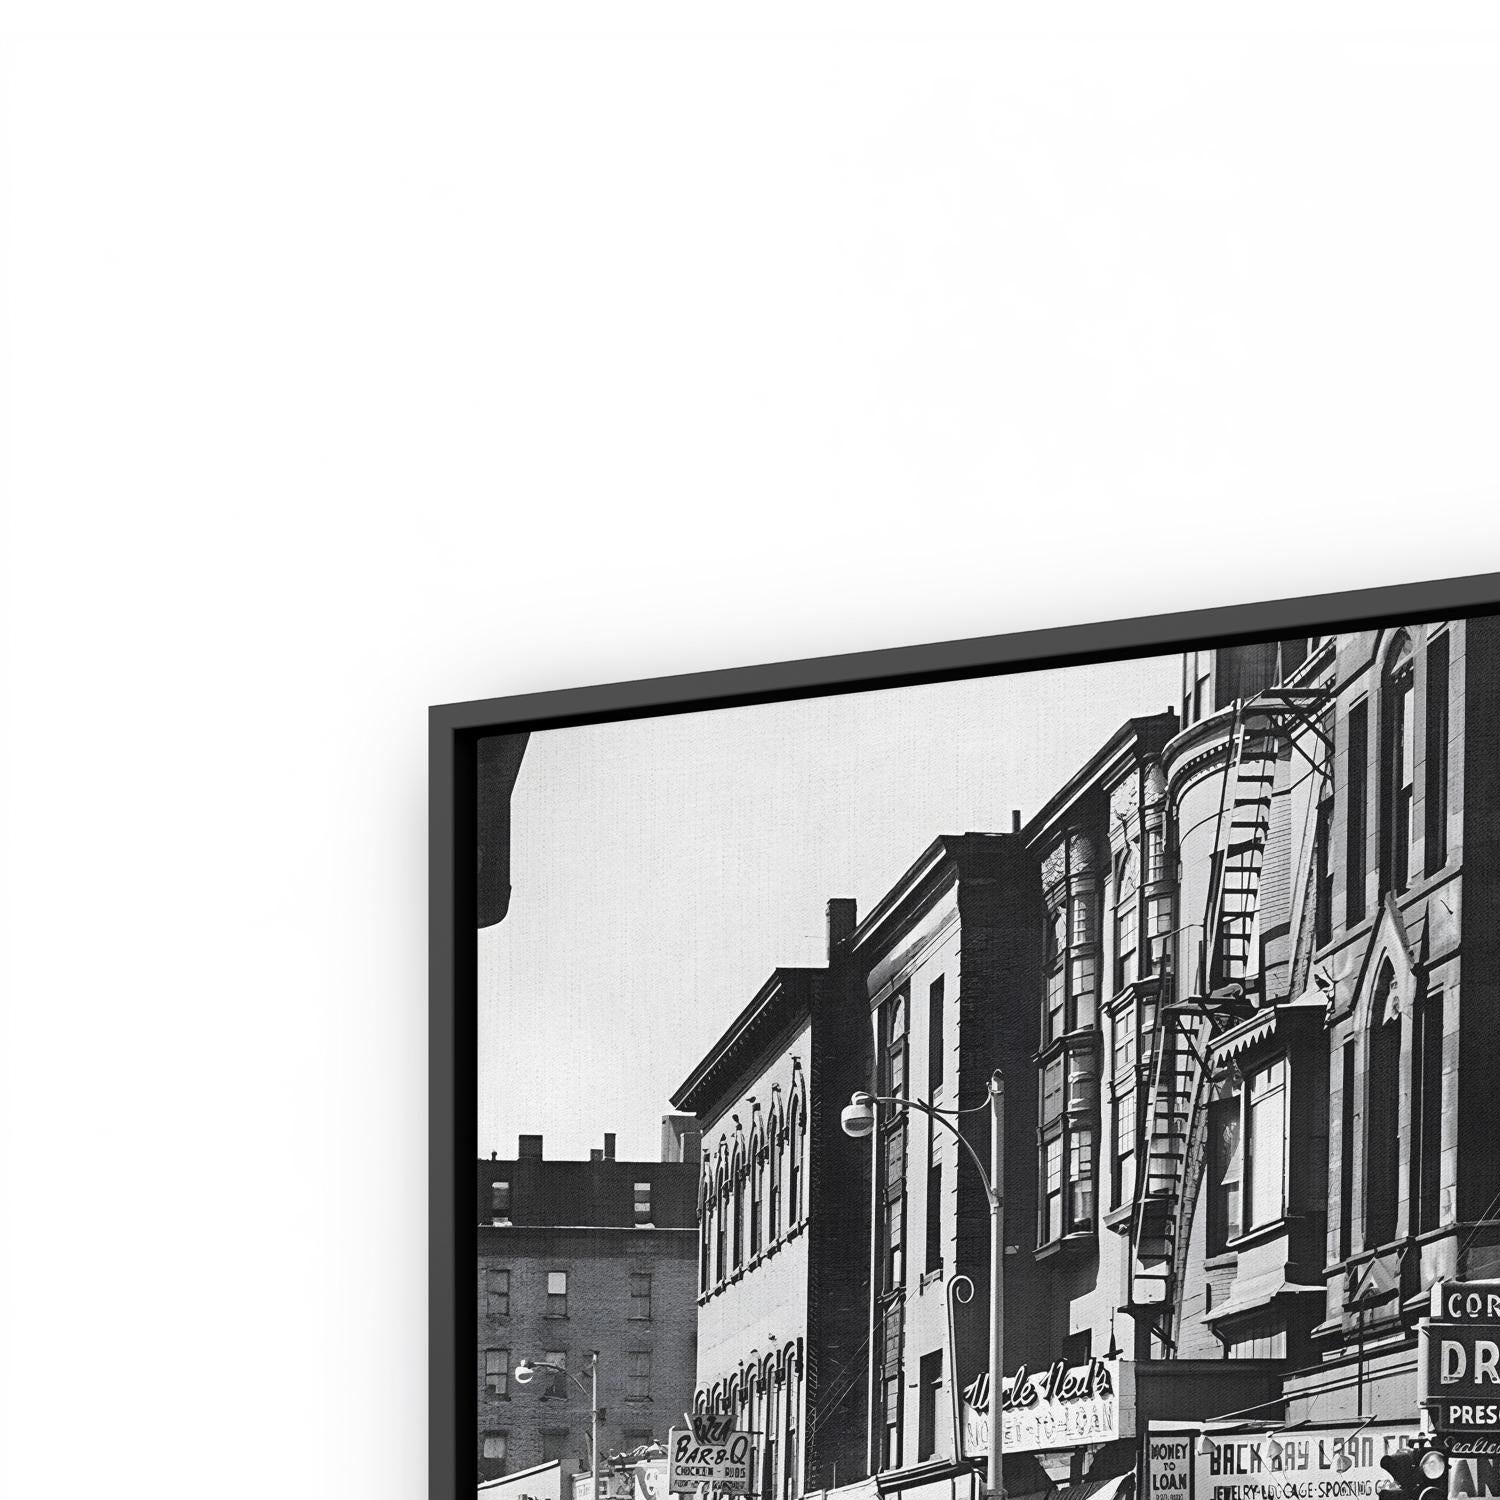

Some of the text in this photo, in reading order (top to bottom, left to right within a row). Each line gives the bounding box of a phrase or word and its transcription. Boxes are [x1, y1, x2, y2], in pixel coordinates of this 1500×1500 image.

[963, 1363, 1038, 1413] Ucle
[1151, 1443, 1188, 1460] MONEY
[1210, 1442, 1262, 1475] BACK
[1163, 1461, 1176, 1472] TO
[1152, 1473, 1187, 1490] LOAN
